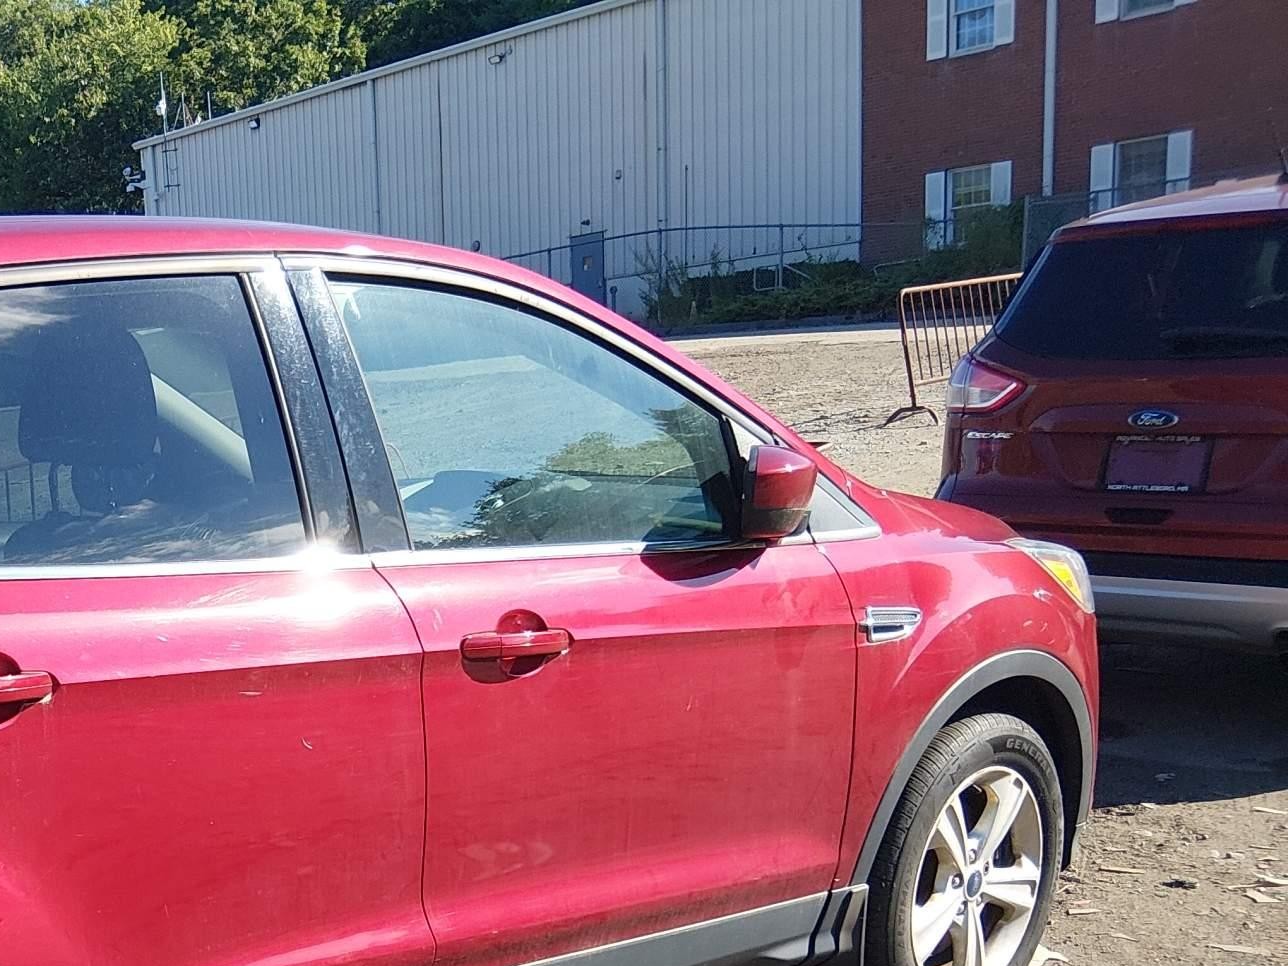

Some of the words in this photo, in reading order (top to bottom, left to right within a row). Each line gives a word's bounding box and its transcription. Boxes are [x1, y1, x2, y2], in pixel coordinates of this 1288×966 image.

[1137, 413, 1167, 425] Ford
[967, 431, 1015, 439] ESCAPE
[1006, 738, 1051, 776] GENERAL
